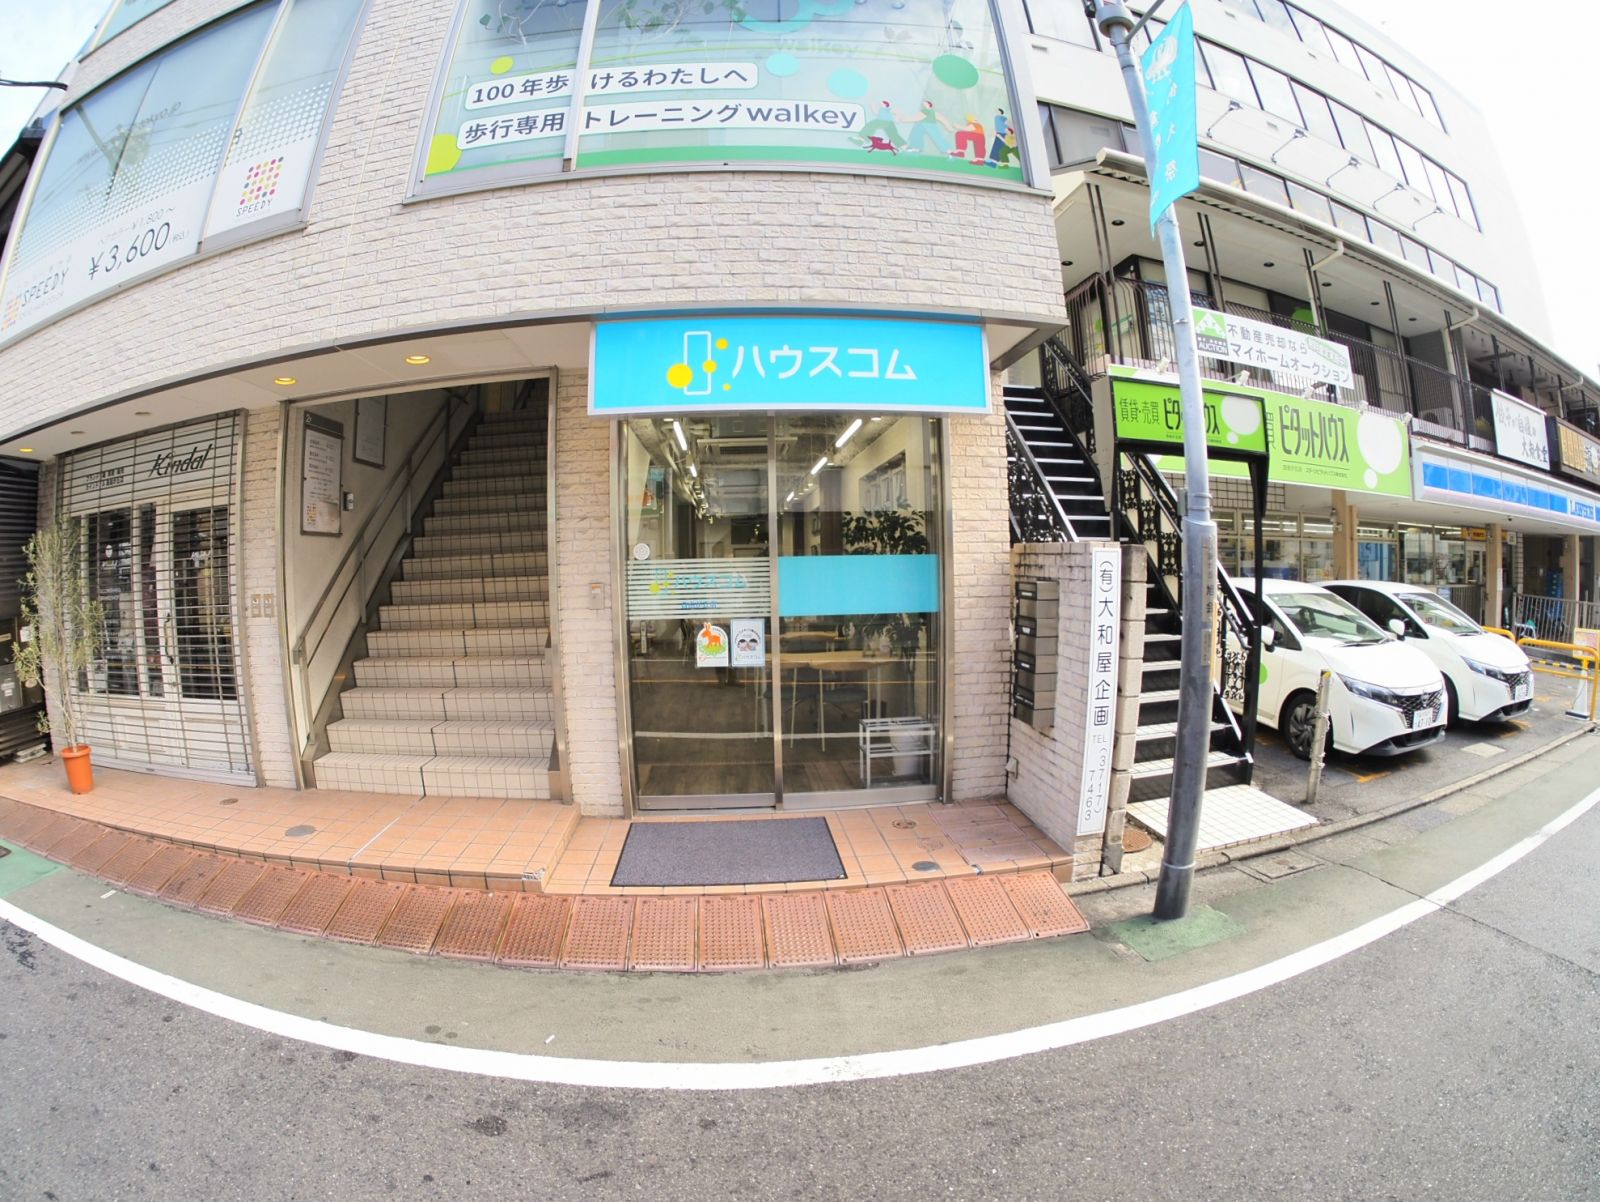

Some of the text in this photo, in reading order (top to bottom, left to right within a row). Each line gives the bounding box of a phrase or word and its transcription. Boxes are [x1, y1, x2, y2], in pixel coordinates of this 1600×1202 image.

[236, 199, 273, 217] SPEEDY
[88, 222, 171, 280] ¥3,600
[21, 266, 70, 307] SPEEDY
[1227, 323, 1308, 355] 不動産売却なら
[732, 344, 917, 380] ハウスコム
[1229, 342, 1349, 383] マイホームオークション
[1119, 398, 1160, 425] 賃貸・売買
[1279, 404, 1350, 463] ピタットハウス
[148, 443, 213, 478] Kindal
[1092, 560, 1115, 727] (有)大和屋企画
[1092, 734, 1107, 744] TEL
[1084, 769, 1096, 822] 7463
